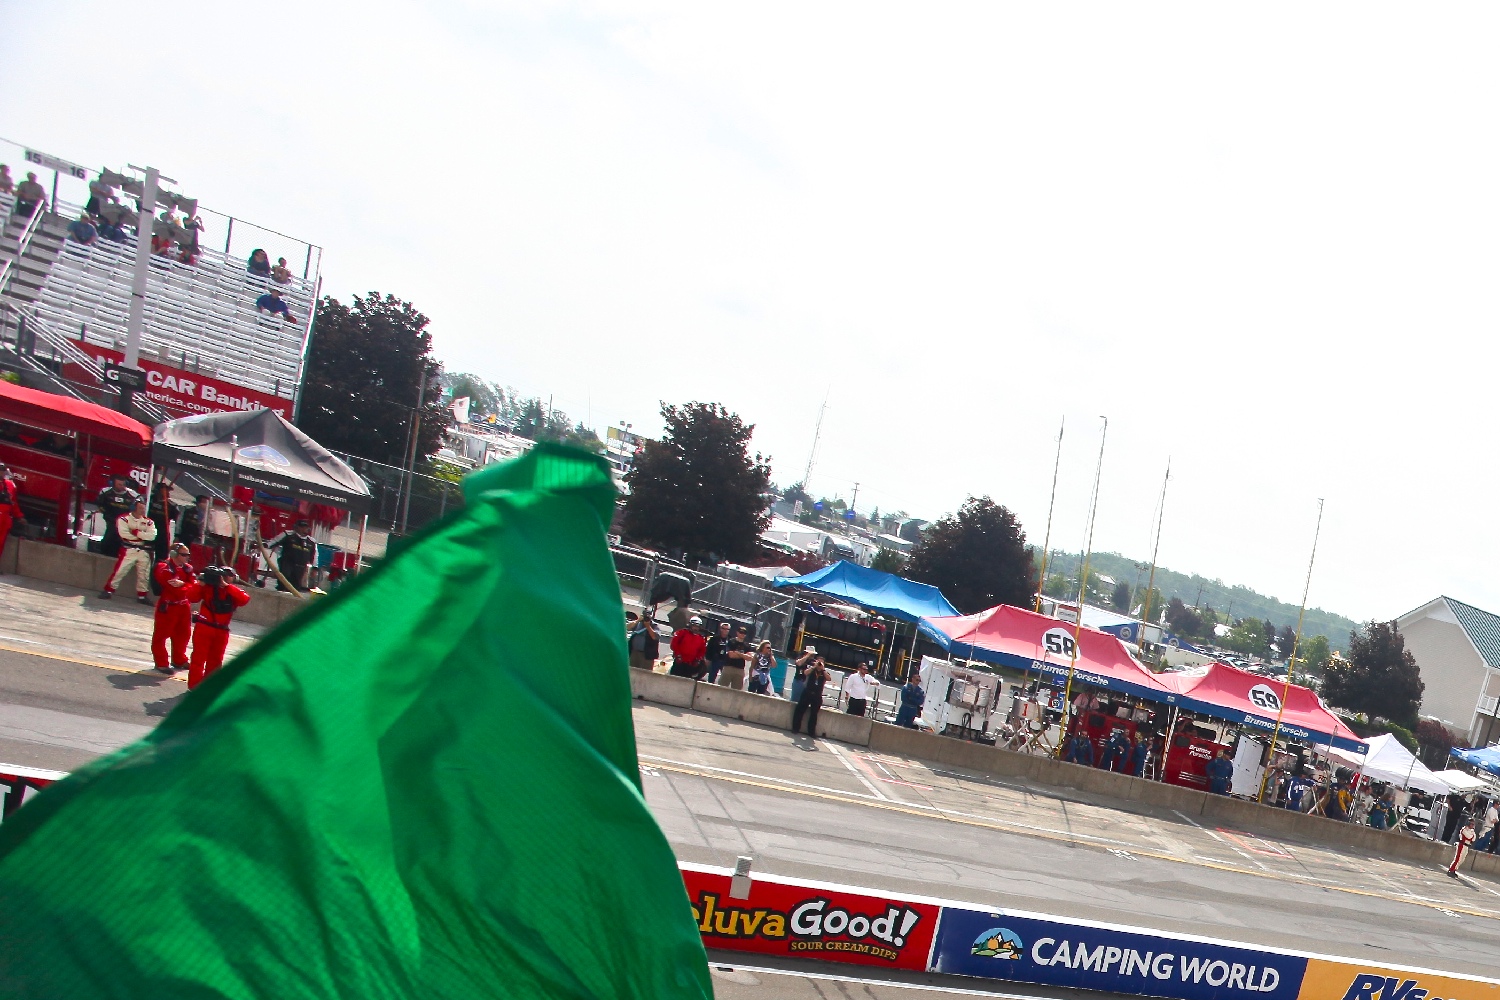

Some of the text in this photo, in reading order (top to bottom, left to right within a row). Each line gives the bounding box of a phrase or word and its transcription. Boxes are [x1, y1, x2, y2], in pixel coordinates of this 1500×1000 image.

[1046, 634, 1077, 659] 58
[1031, 661, 1109, 686] Brumos Porsche
[1251, 689, 1280, 711] 59
[1244, 715, 1309, 738] Brumos Porsche
[790, 900, 918, 947] Good!
[791, 941, 897, 961] SOUR CREAM DIPS
[1031, 938, 1280, 993] CAMPING WORLD
